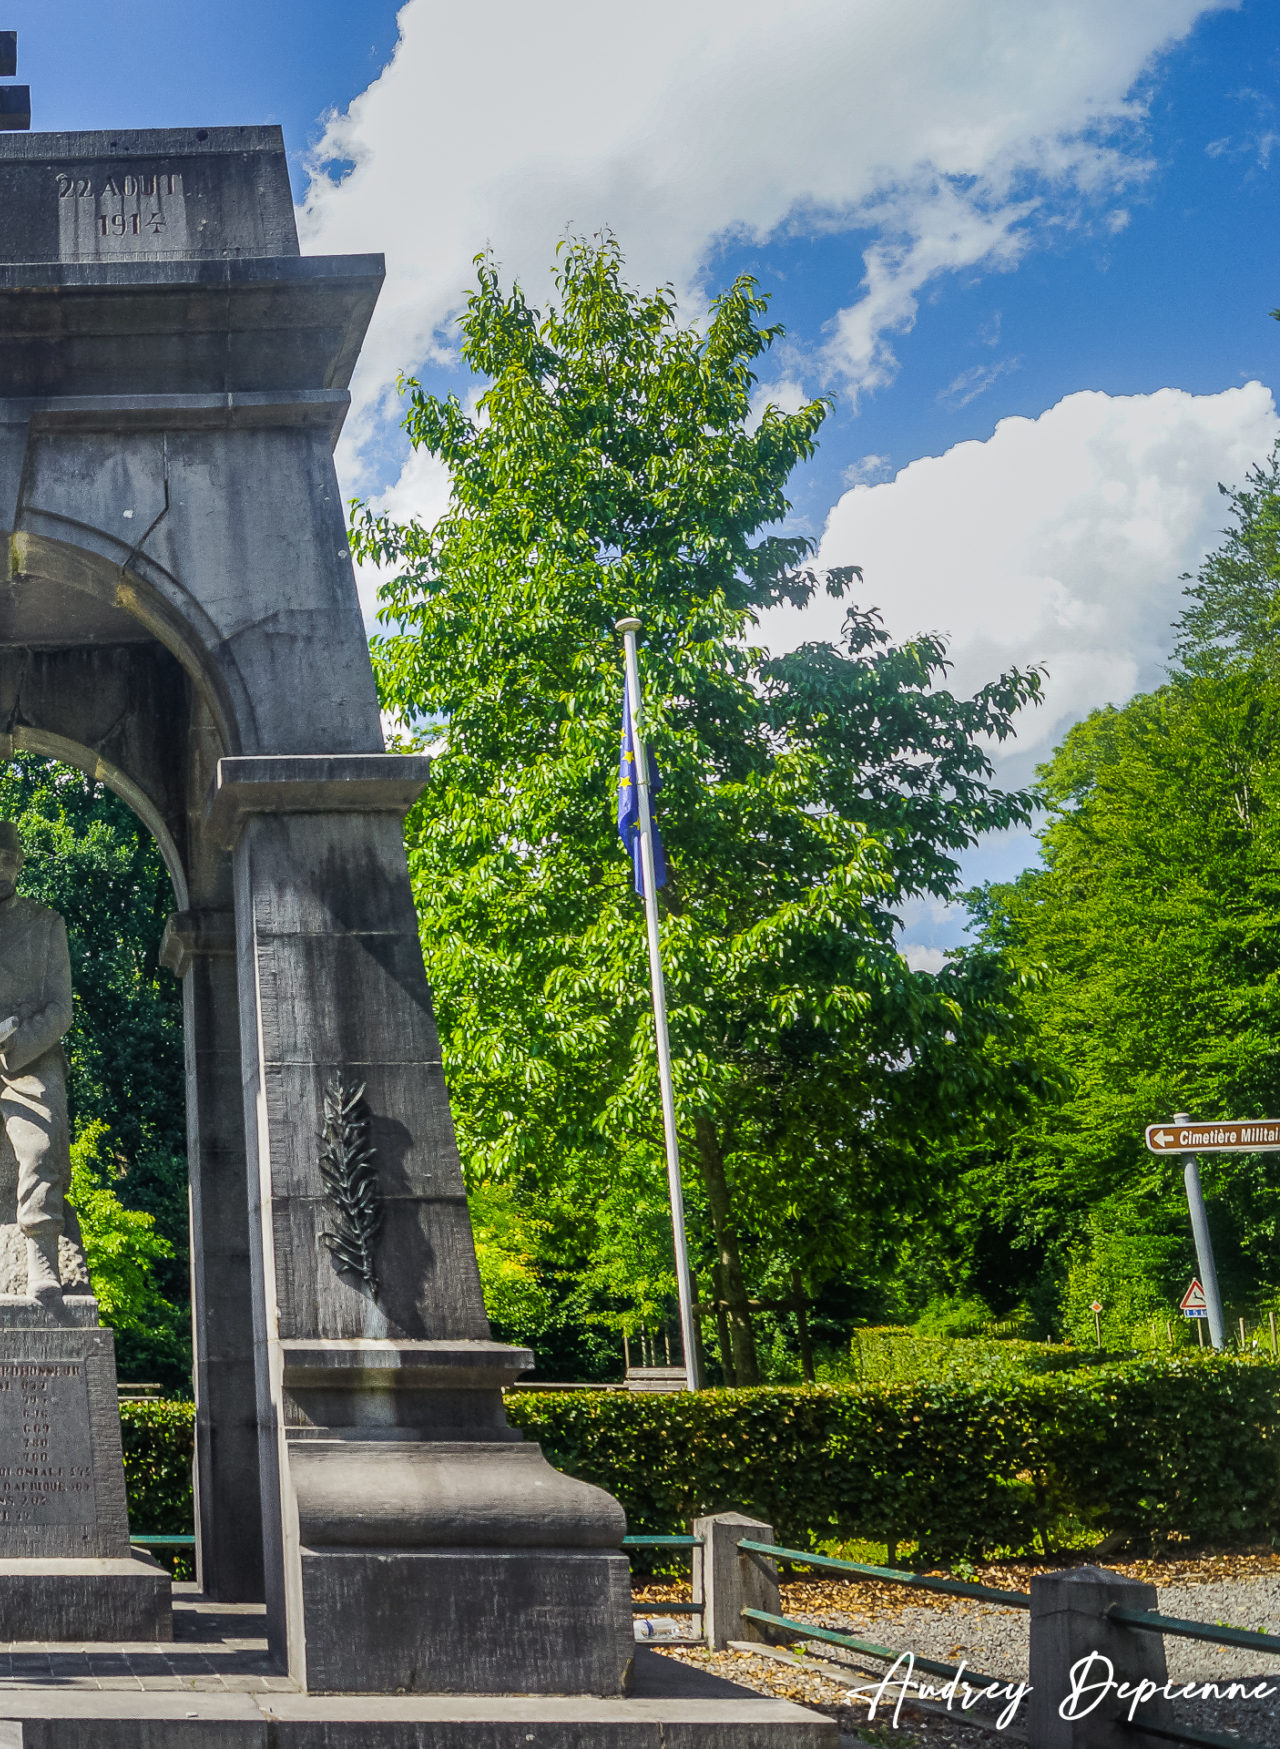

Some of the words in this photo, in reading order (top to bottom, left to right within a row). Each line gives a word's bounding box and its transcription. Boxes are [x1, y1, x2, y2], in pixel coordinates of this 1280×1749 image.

[55, 173, 94, 199] 22
[98, 213, 167, 237] 1914
[1180, 1128, 1237, 1145] Cimetière
[1241, 1126, 1280, 1142] Militai
